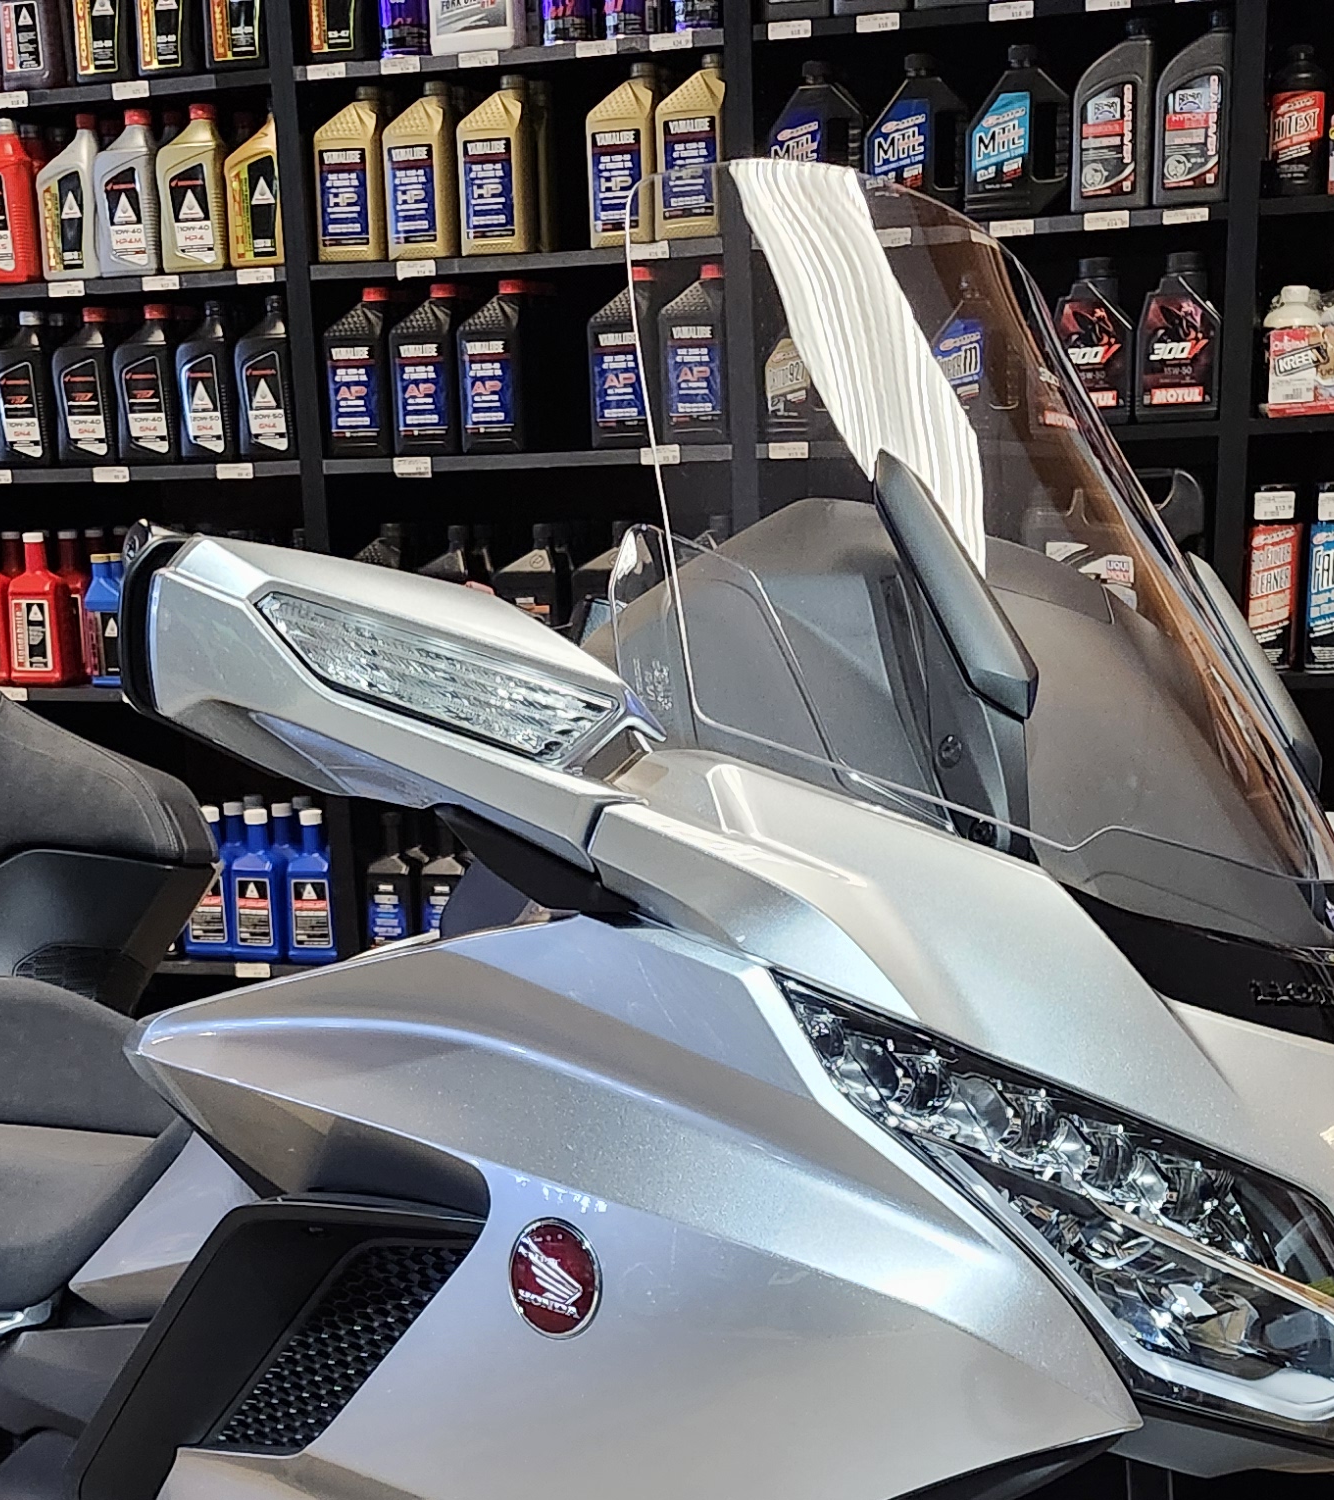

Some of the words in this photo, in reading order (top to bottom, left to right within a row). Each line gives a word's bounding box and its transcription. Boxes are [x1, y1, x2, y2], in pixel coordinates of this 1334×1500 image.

[3, 5, 12, 28] OIL
[215, 8, 229, 54] FORK
[78, 26, 91, 67] FORK
[141, 22, 153, 63] FORK
[5, 32, 15, 70] FORK
[669, 118, 711, 134] YAMALUBE
[595, 131, 636, 146] YAMALUBE
[391, 147, 428, 162] YAMALUBE
[467, 140, 507, 156] YAMALUBE
[323, 151, 362, 164] YAMALUBE
[472, 184, 503, 198] HP
[600, 176, 632, 192] HP
[329, 193, 358, 206] HP
[397, 189, 426, 204] HP
[1149, 339, 1210, 361] 300V
[603, 372, 636, 388] AP
[677, 366, 711, 382] AP
[336, 386, 368, 400] AP
[404, 383, 436, 398] AP
[471, 380, 503, 395] AP
[1152, 388, 1203, 403] MOTUL
[1250, 566, 1291, 599] CLEANER
[518, 1288, 581, 1319] HONDA
